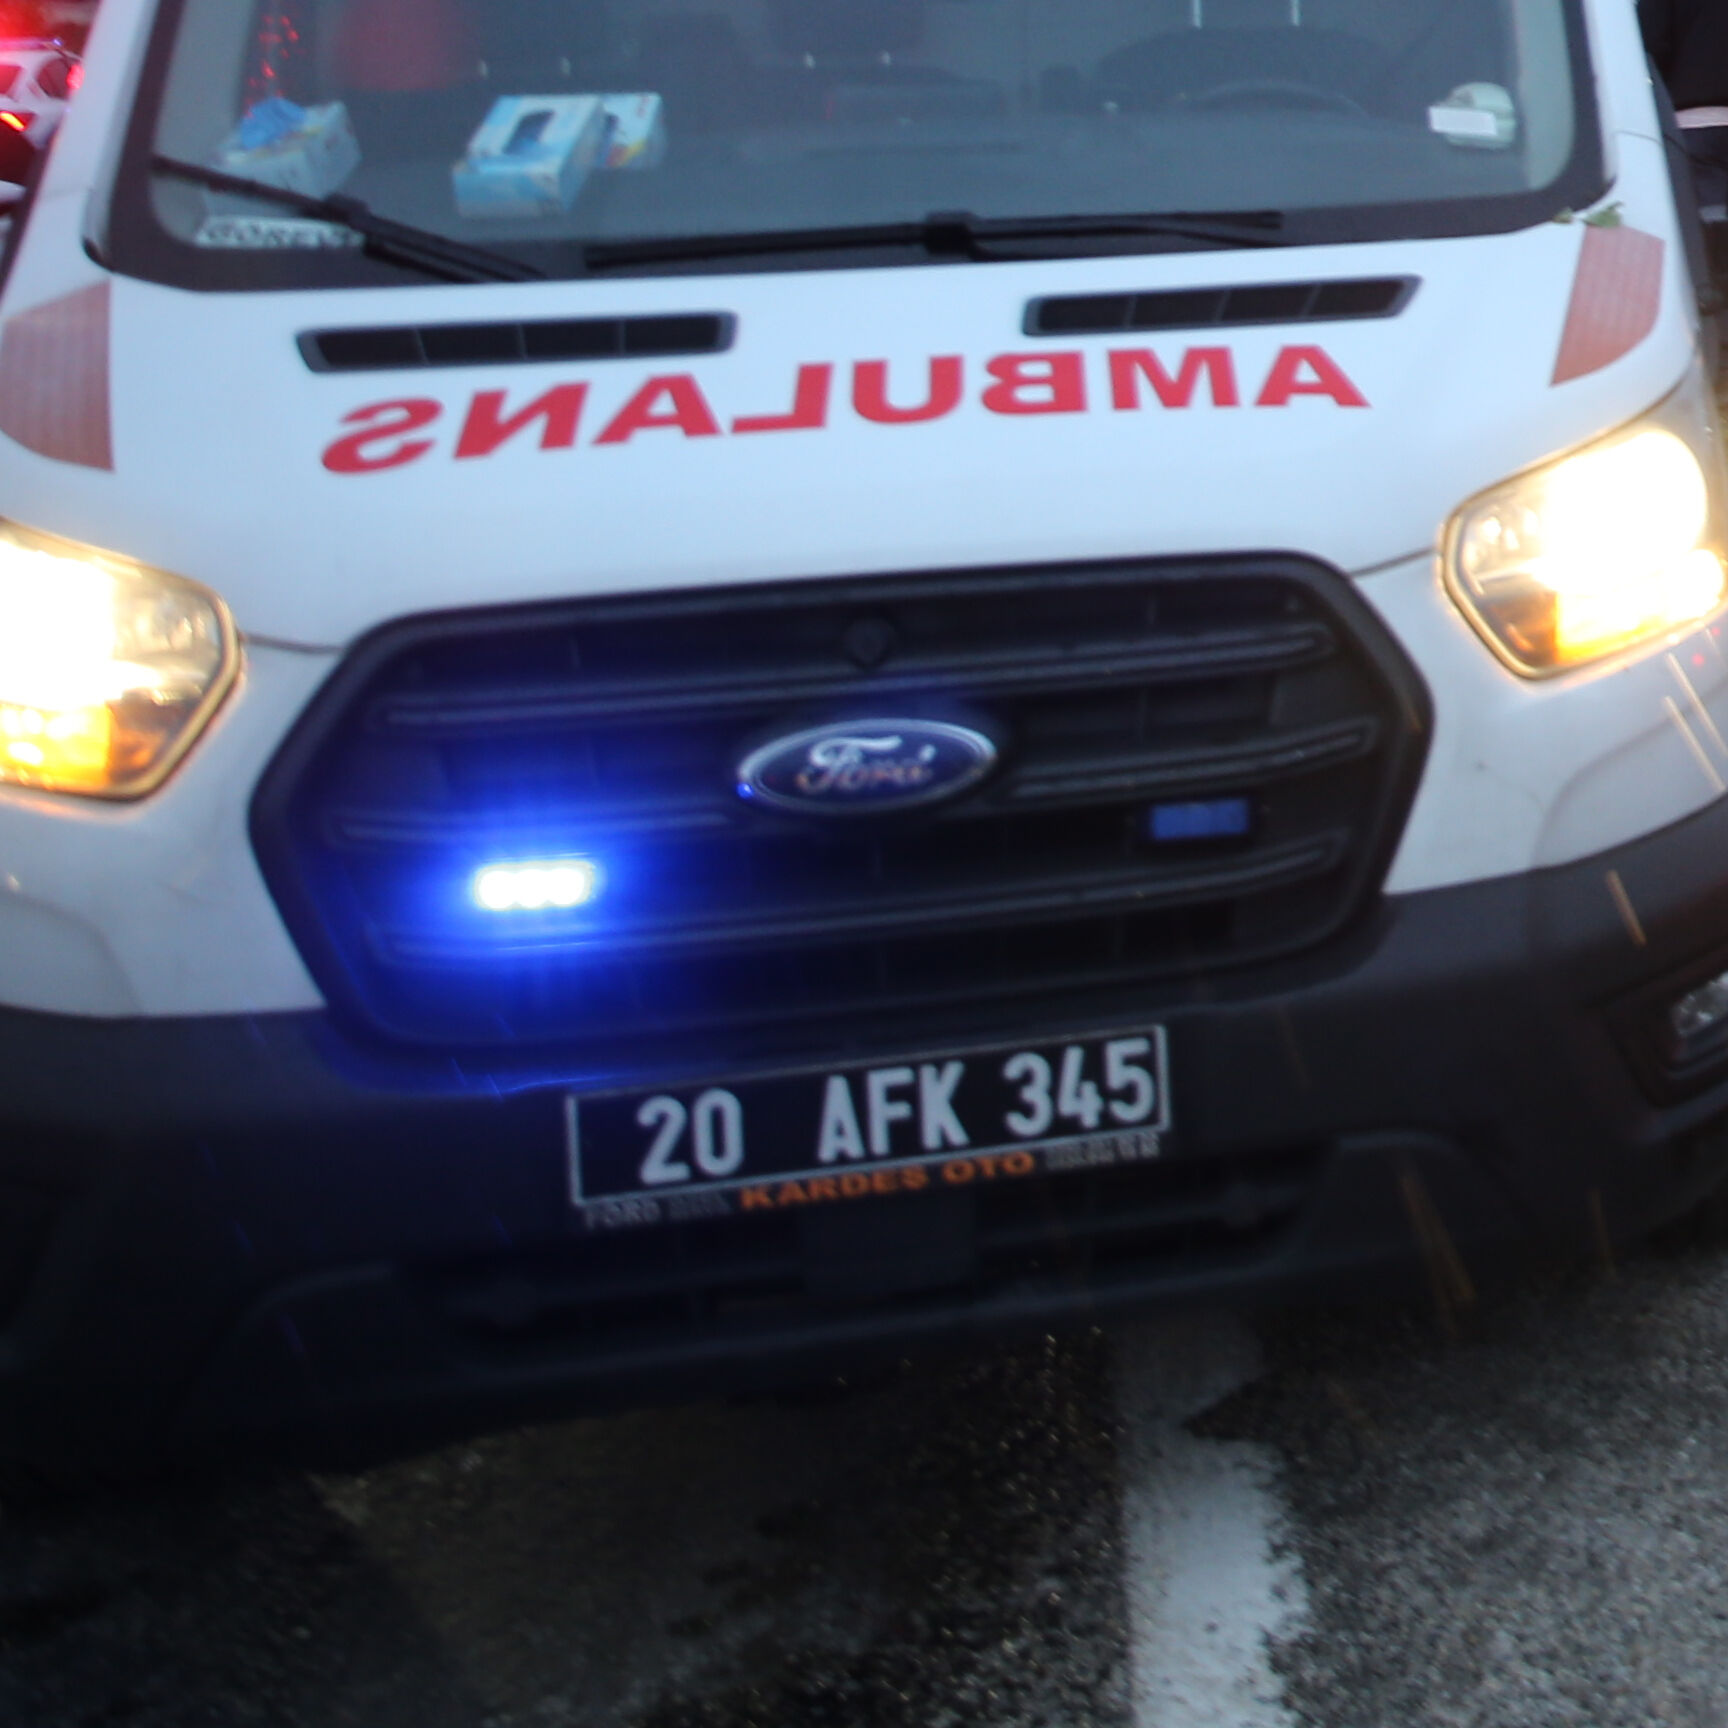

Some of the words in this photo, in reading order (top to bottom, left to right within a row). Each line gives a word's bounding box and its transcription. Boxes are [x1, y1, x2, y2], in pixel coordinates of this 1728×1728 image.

[796, 734, 937, 795] Ford
[636, 1087, 744, 1185] 20
[816, 1060, 972, 1165] AFK
[1003, 1036, 1156, 1138] 345
[939, 1150, 1036, 1184] OTO
